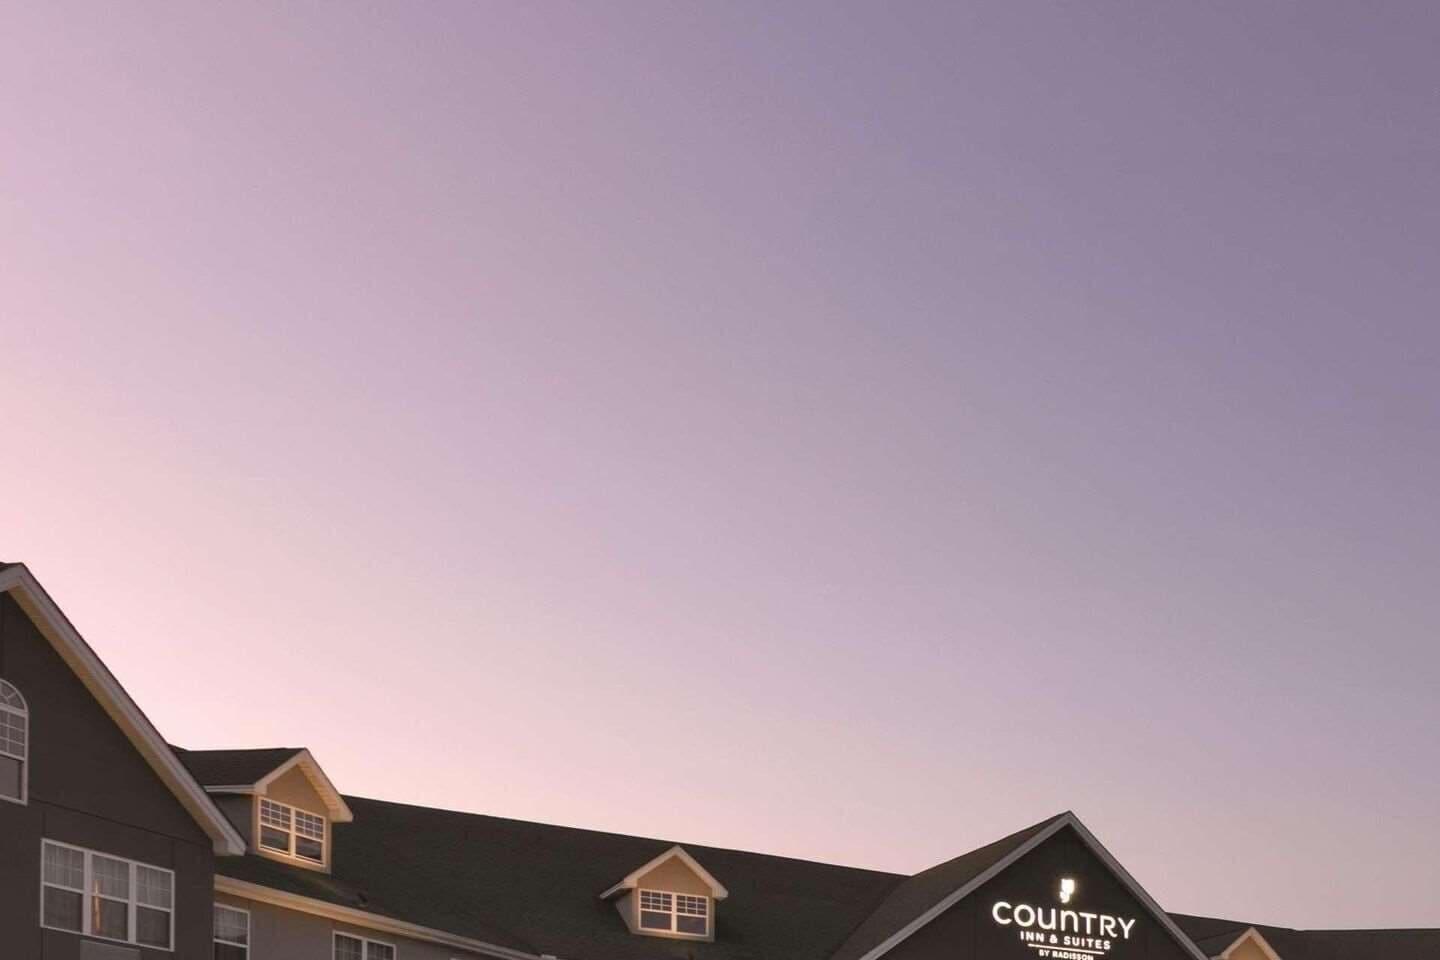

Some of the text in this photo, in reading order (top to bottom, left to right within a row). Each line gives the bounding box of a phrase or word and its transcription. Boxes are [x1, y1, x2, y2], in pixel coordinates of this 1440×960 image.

[1020, 931, 1111, 950] INN & SUITES
[1039, 949, 1050, 957] BY
